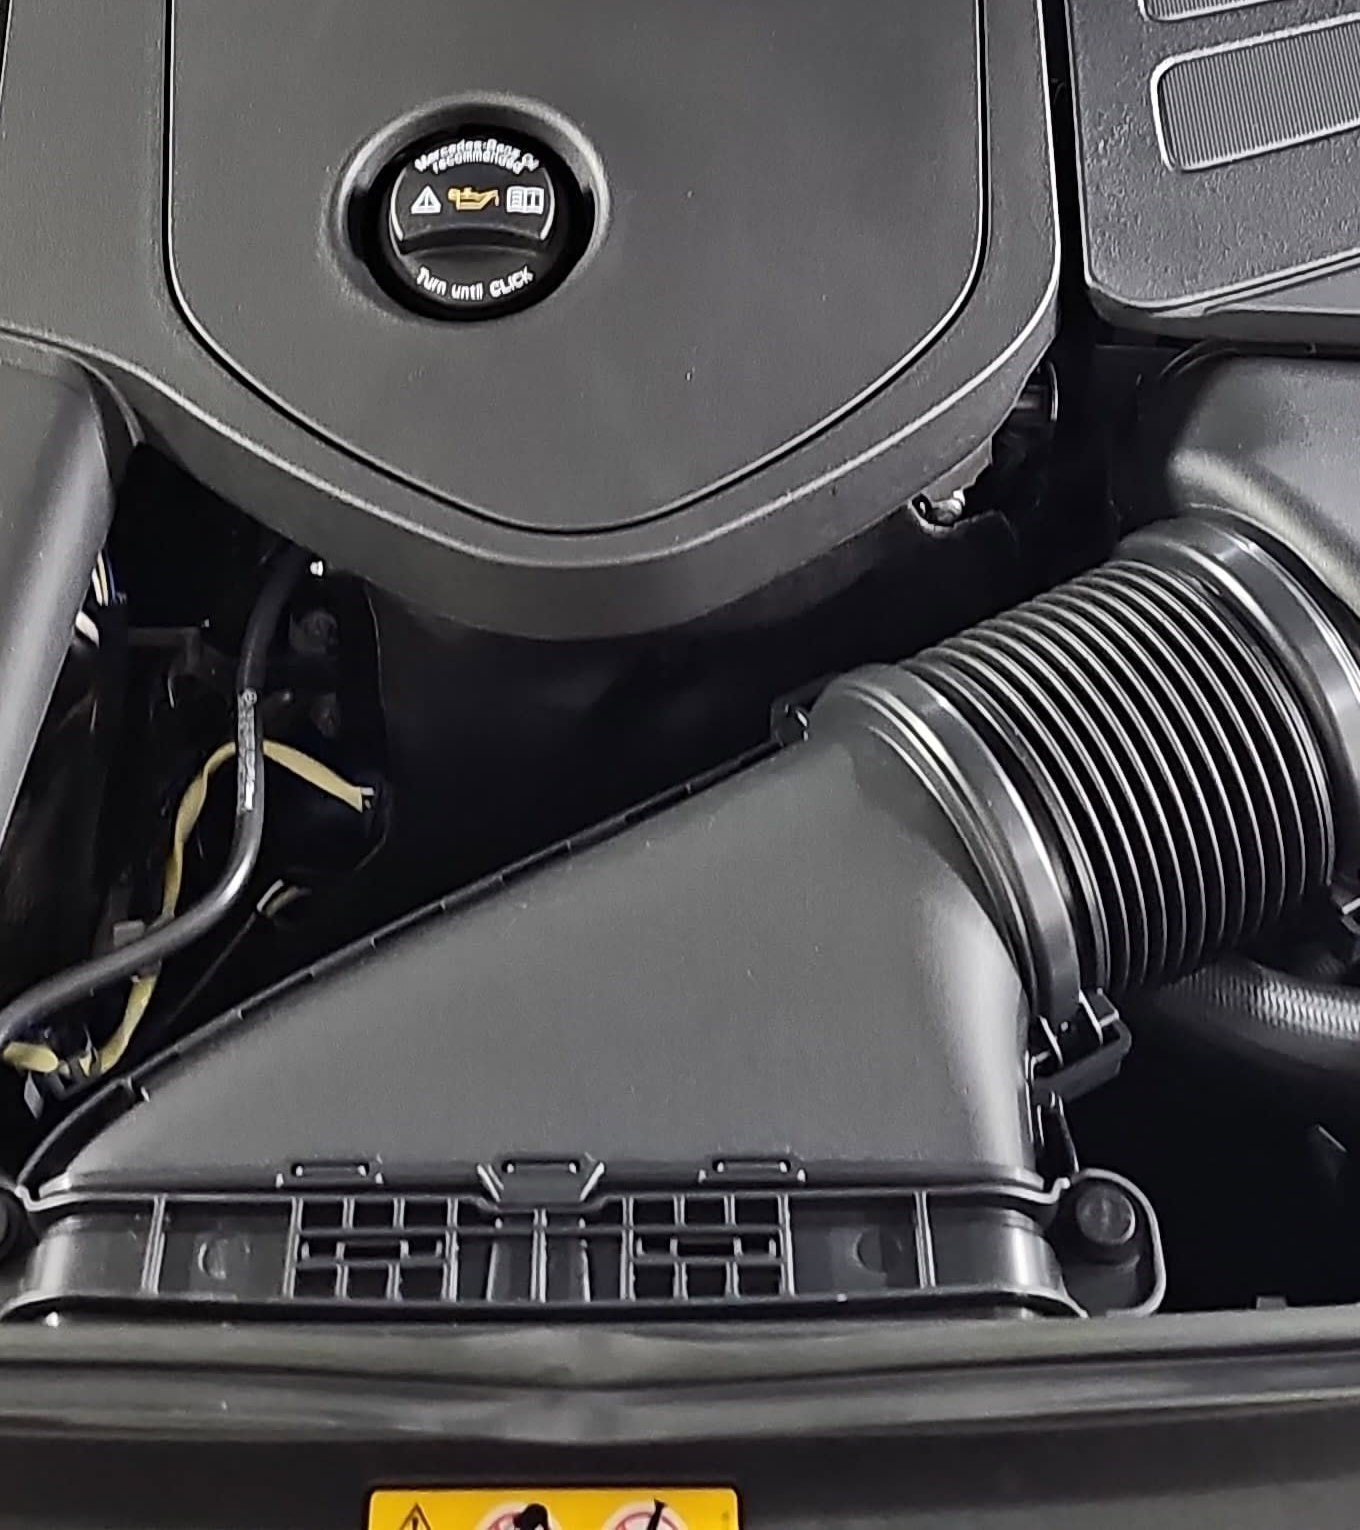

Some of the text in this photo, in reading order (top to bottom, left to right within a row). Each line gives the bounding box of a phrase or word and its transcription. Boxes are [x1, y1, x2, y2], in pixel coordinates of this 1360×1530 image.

[416, 265, 534, 301] Turn until CLICK
